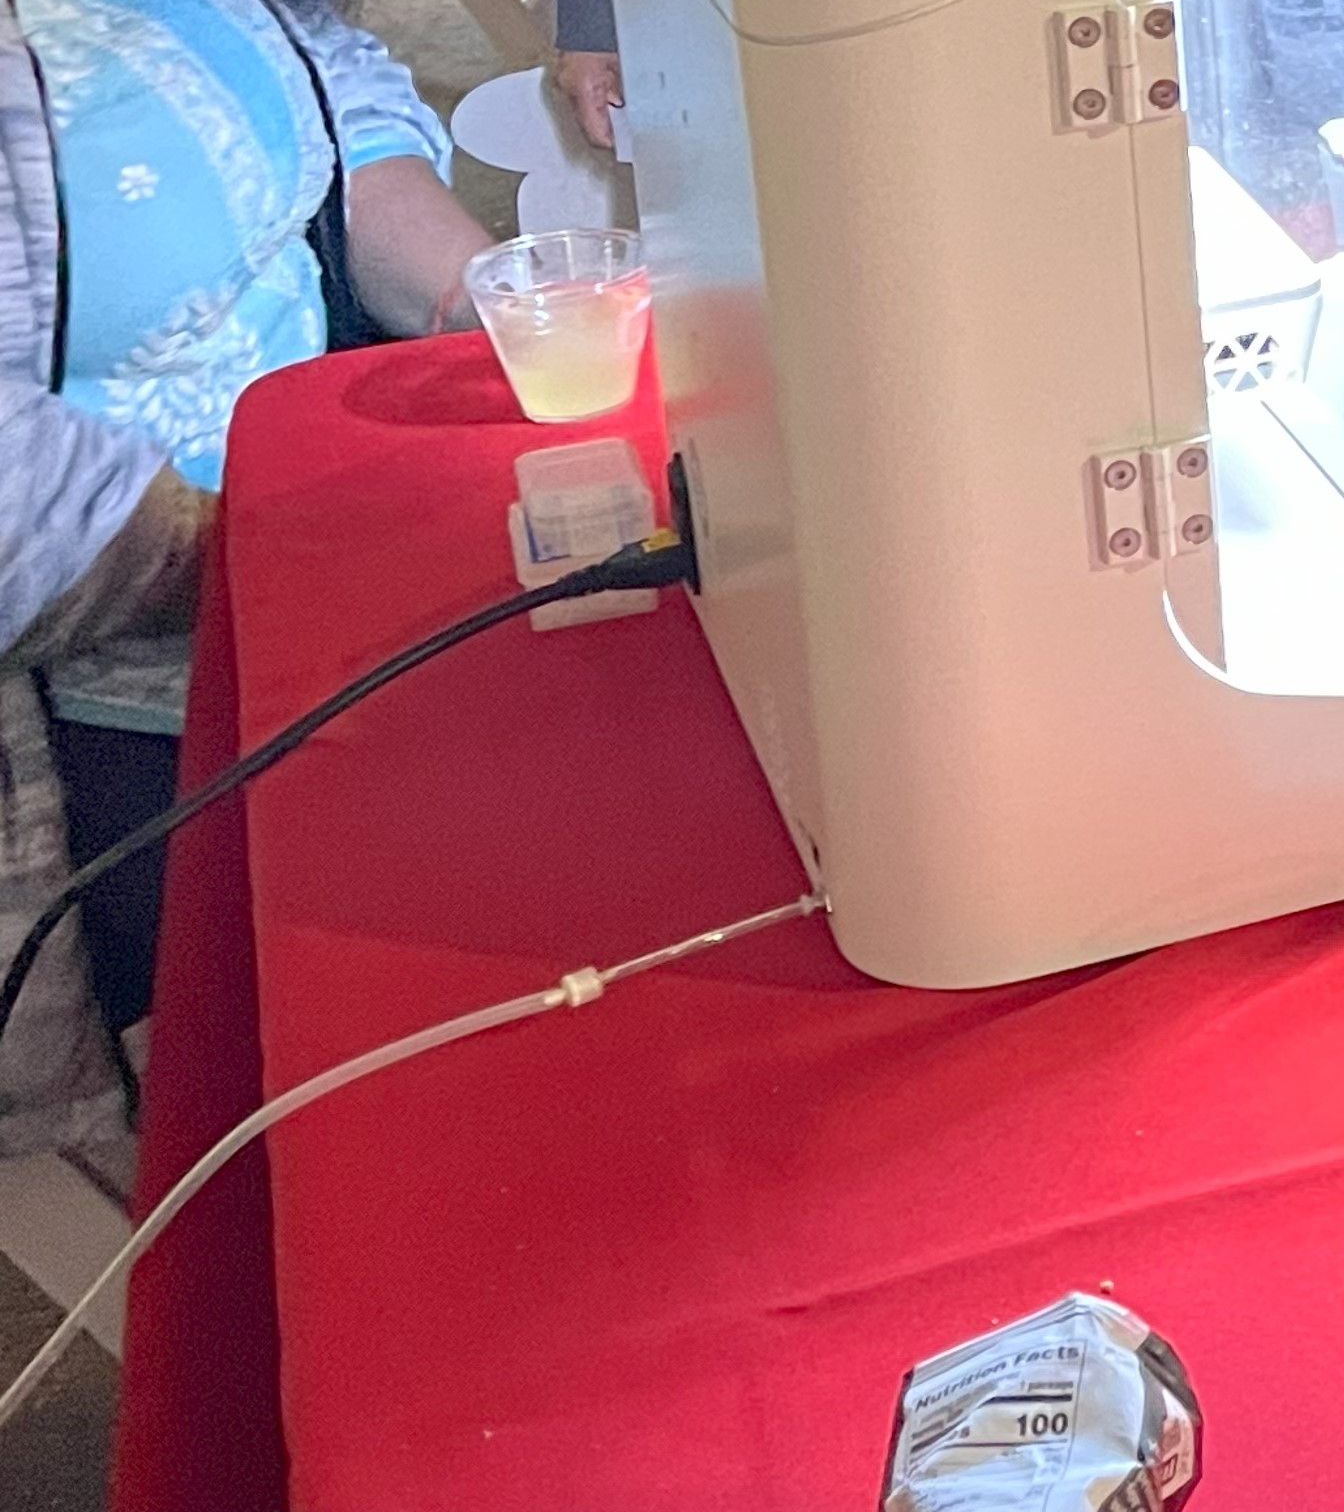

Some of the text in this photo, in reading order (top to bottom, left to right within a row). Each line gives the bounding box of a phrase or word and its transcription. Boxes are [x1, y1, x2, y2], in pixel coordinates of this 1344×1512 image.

[914, 1344, 1080, 1412] Nutrition Facts
[1017, 1412, 1069, 1436] 100
